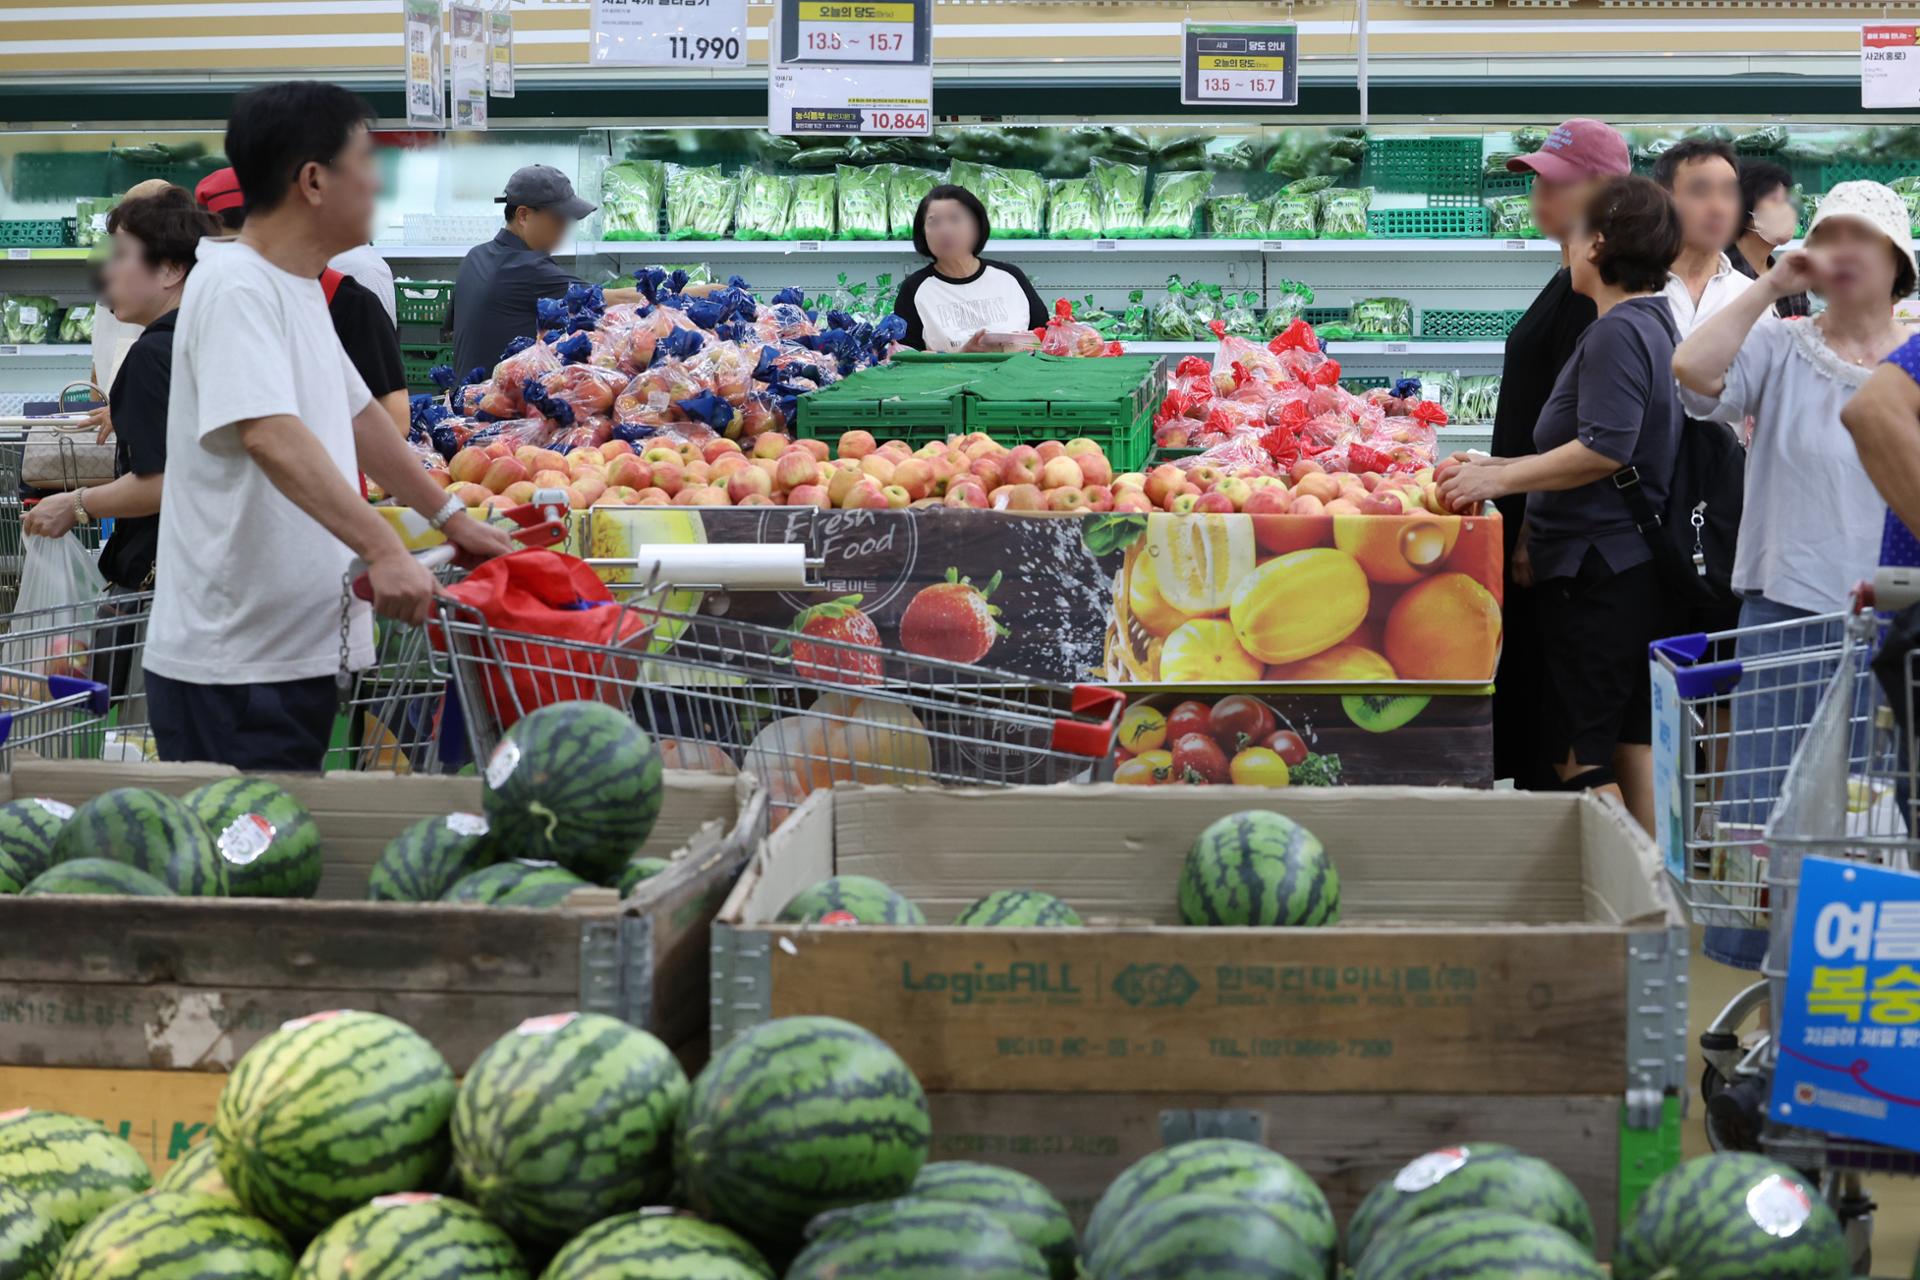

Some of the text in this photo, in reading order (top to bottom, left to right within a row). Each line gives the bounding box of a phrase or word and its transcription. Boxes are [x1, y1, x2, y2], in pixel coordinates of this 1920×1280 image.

[820, 7, 851, 18] 오늘의
[670, 37, 740, 61] 11,990
[807, 32, 842, 50] 13.5
[868, 34, 903, 51] 15.7
[1248, 41, 1286, 51] 당도 안내
[1214, 59, 1237, 68] 오늘의
[1865, 52, 1906, 61] 사과(홍로)
[1205, 78, 1229, 92] 13.5
[1249, 79, 1275, 92] 15.7
[795, 111, 826, 121] 농식품부
[871, 113, 927, 130] 10,864
[822, 524, 897, 561] Food
[1813, 901, 1920, 961] 여름
[903, 961, 1081, 1004] LogisALL
[1806, 965, 1920, 1025] 복숭
